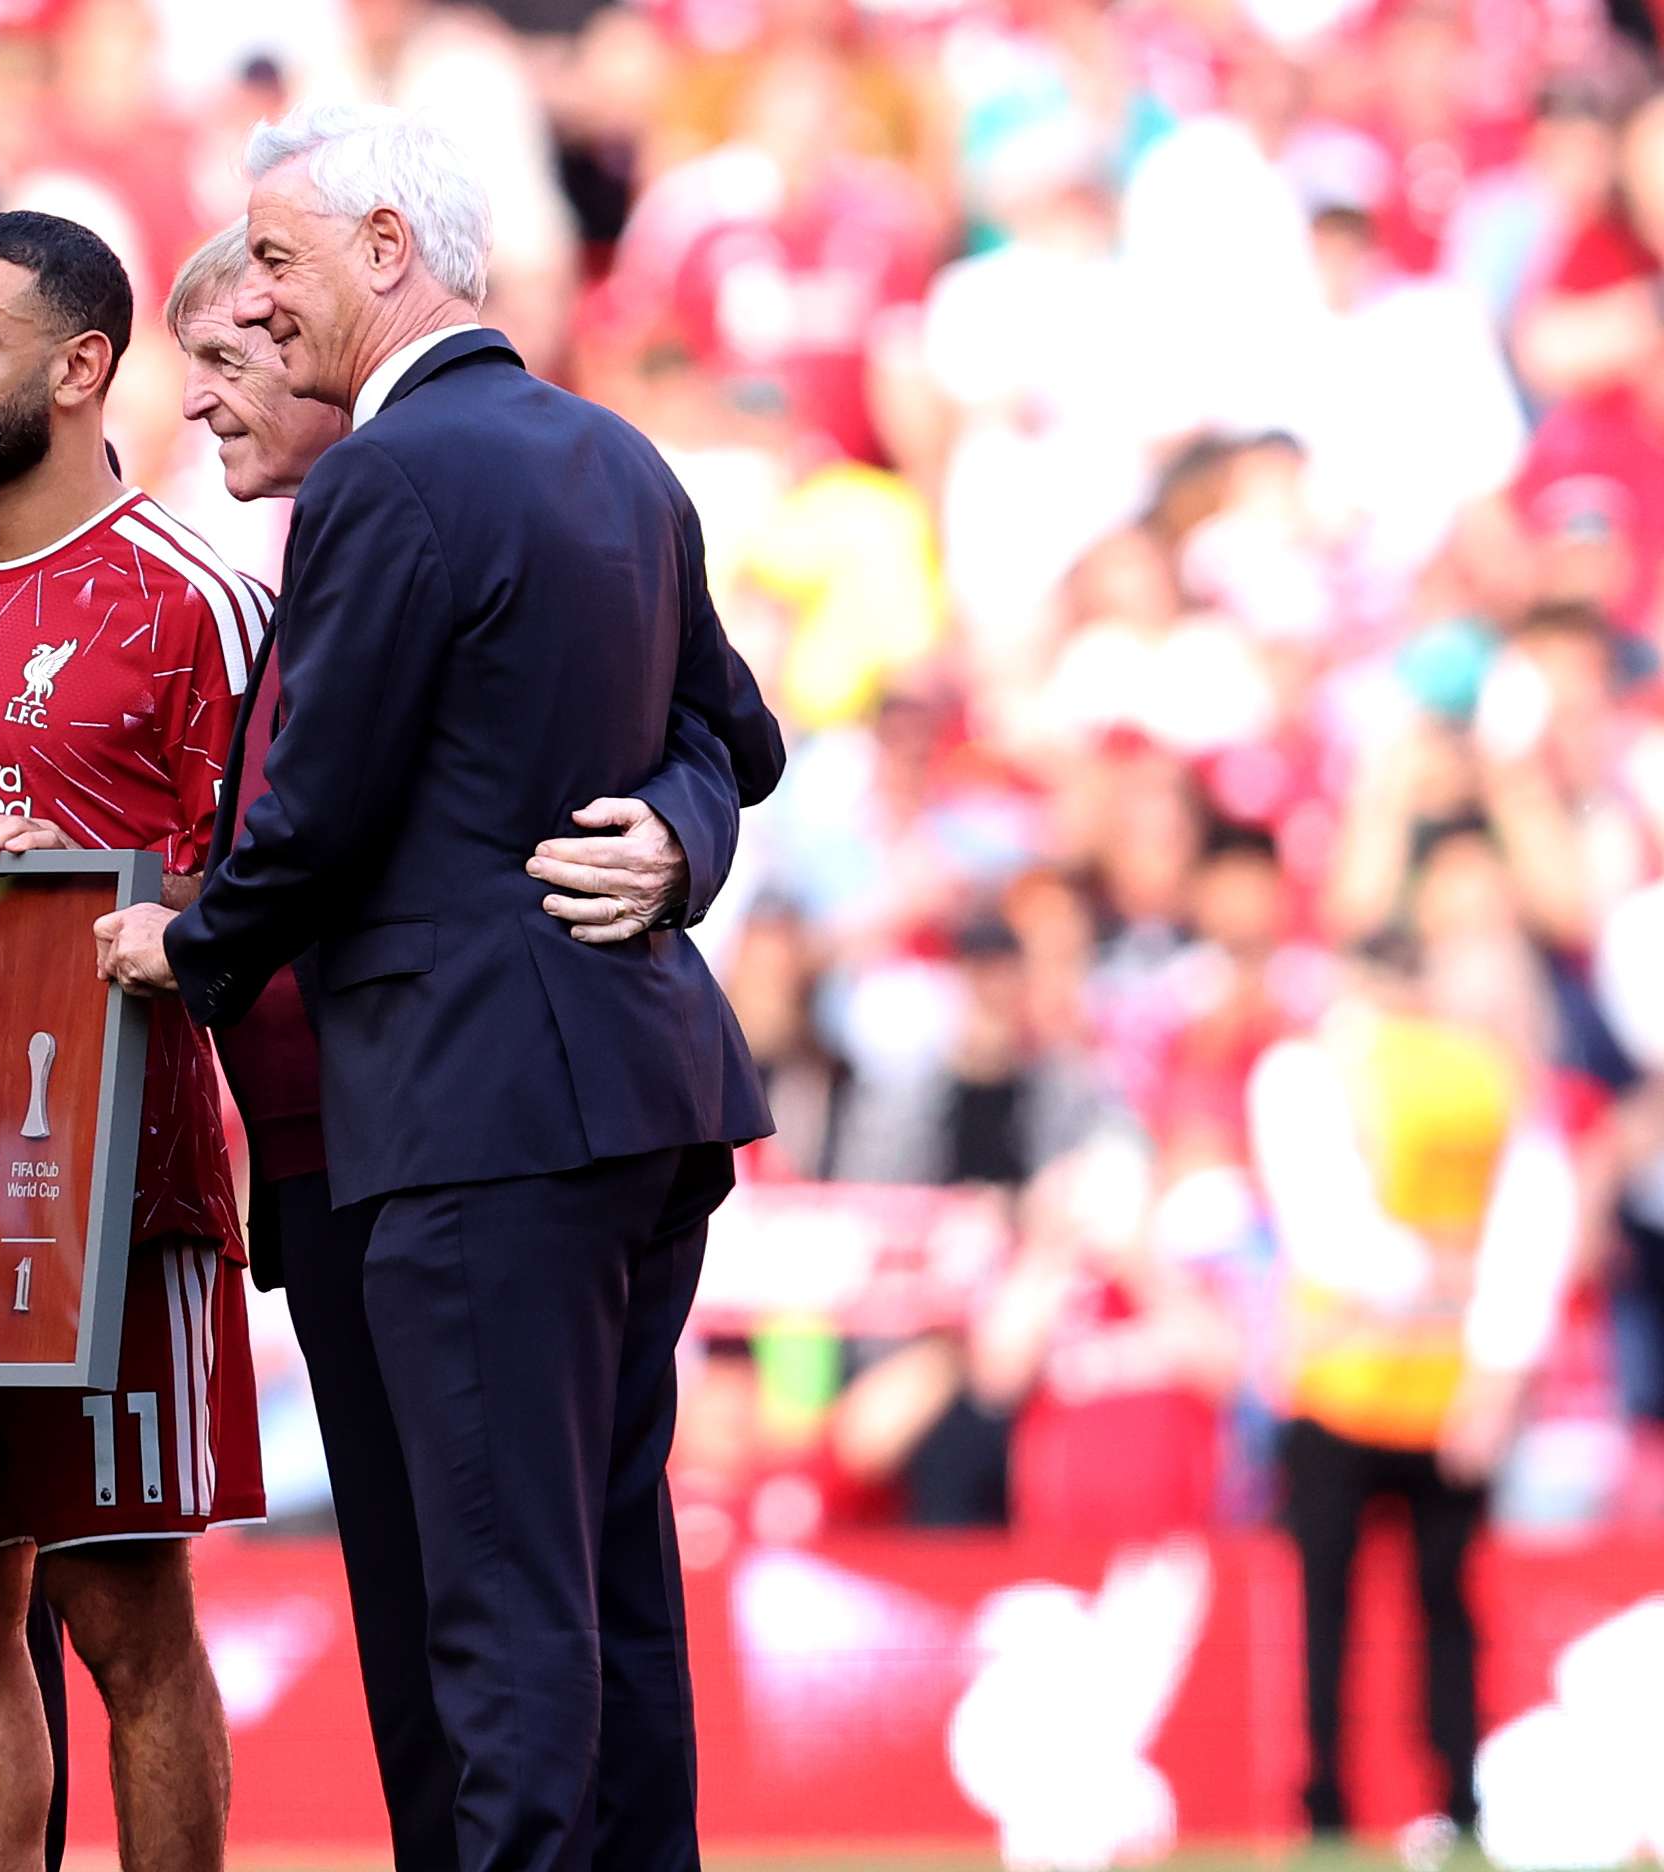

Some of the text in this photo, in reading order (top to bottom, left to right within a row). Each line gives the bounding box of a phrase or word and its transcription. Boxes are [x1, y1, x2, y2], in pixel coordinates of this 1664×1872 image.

[11, 1161, 60, 1178] FIFA Club
[6, 1182, 60, 1201] World Cup
[13, 1257, 32, 1312] 1
[82, 1391, 163, 1507] 11
